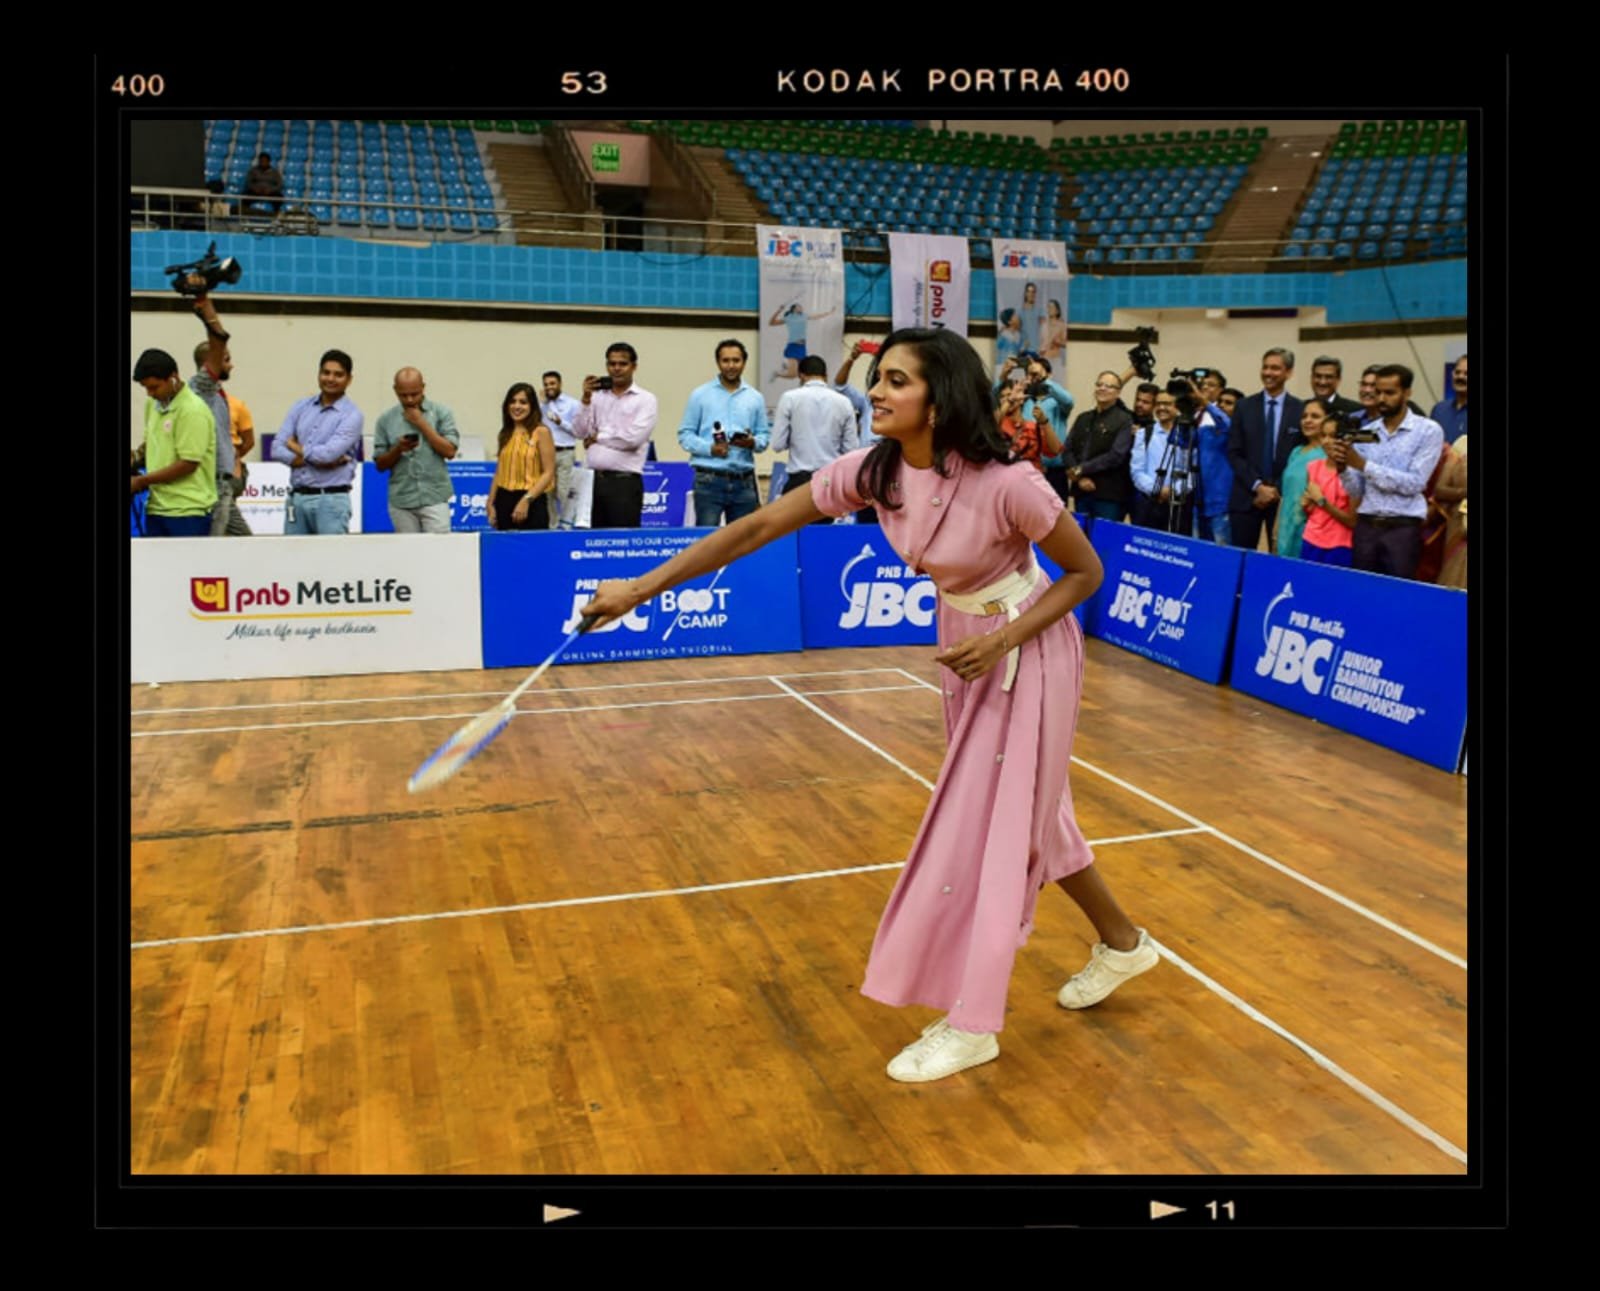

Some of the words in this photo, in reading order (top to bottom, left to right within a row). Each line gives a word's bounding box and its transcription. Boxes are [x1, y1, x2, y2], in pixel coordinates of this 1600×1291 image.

[764, 240, 802, 257] JBC
[1001, 254, 1029, 269] JBC
[930, 284, 946, 319] pnb
[241, 484, 259, 497] nb
[261, 484, 292, 497] Met
[876, 566, 902, 579] PNB
[235, 582, 291, 613] pnb
[297, 579, 412, 605] MetLife
[661, 588, 731, 613] BOOT
[838, 581, 937, 630] JBC
[1108, 582, 1153, 629] JBC
[561, 594, 652, 635] JC
[678, 614, 728, 629] CAMP
[1288, 610, 1310, 629] PNB
[1309, 615, 1346, 640] MetLife
[1158, 621, 1185, 641] CAMP
[1254, 625, 1335, 695] JBC
[1339, 650, 1384, 677] JUNIOR
[1334, 667, 1405, 702] BADMINTON
